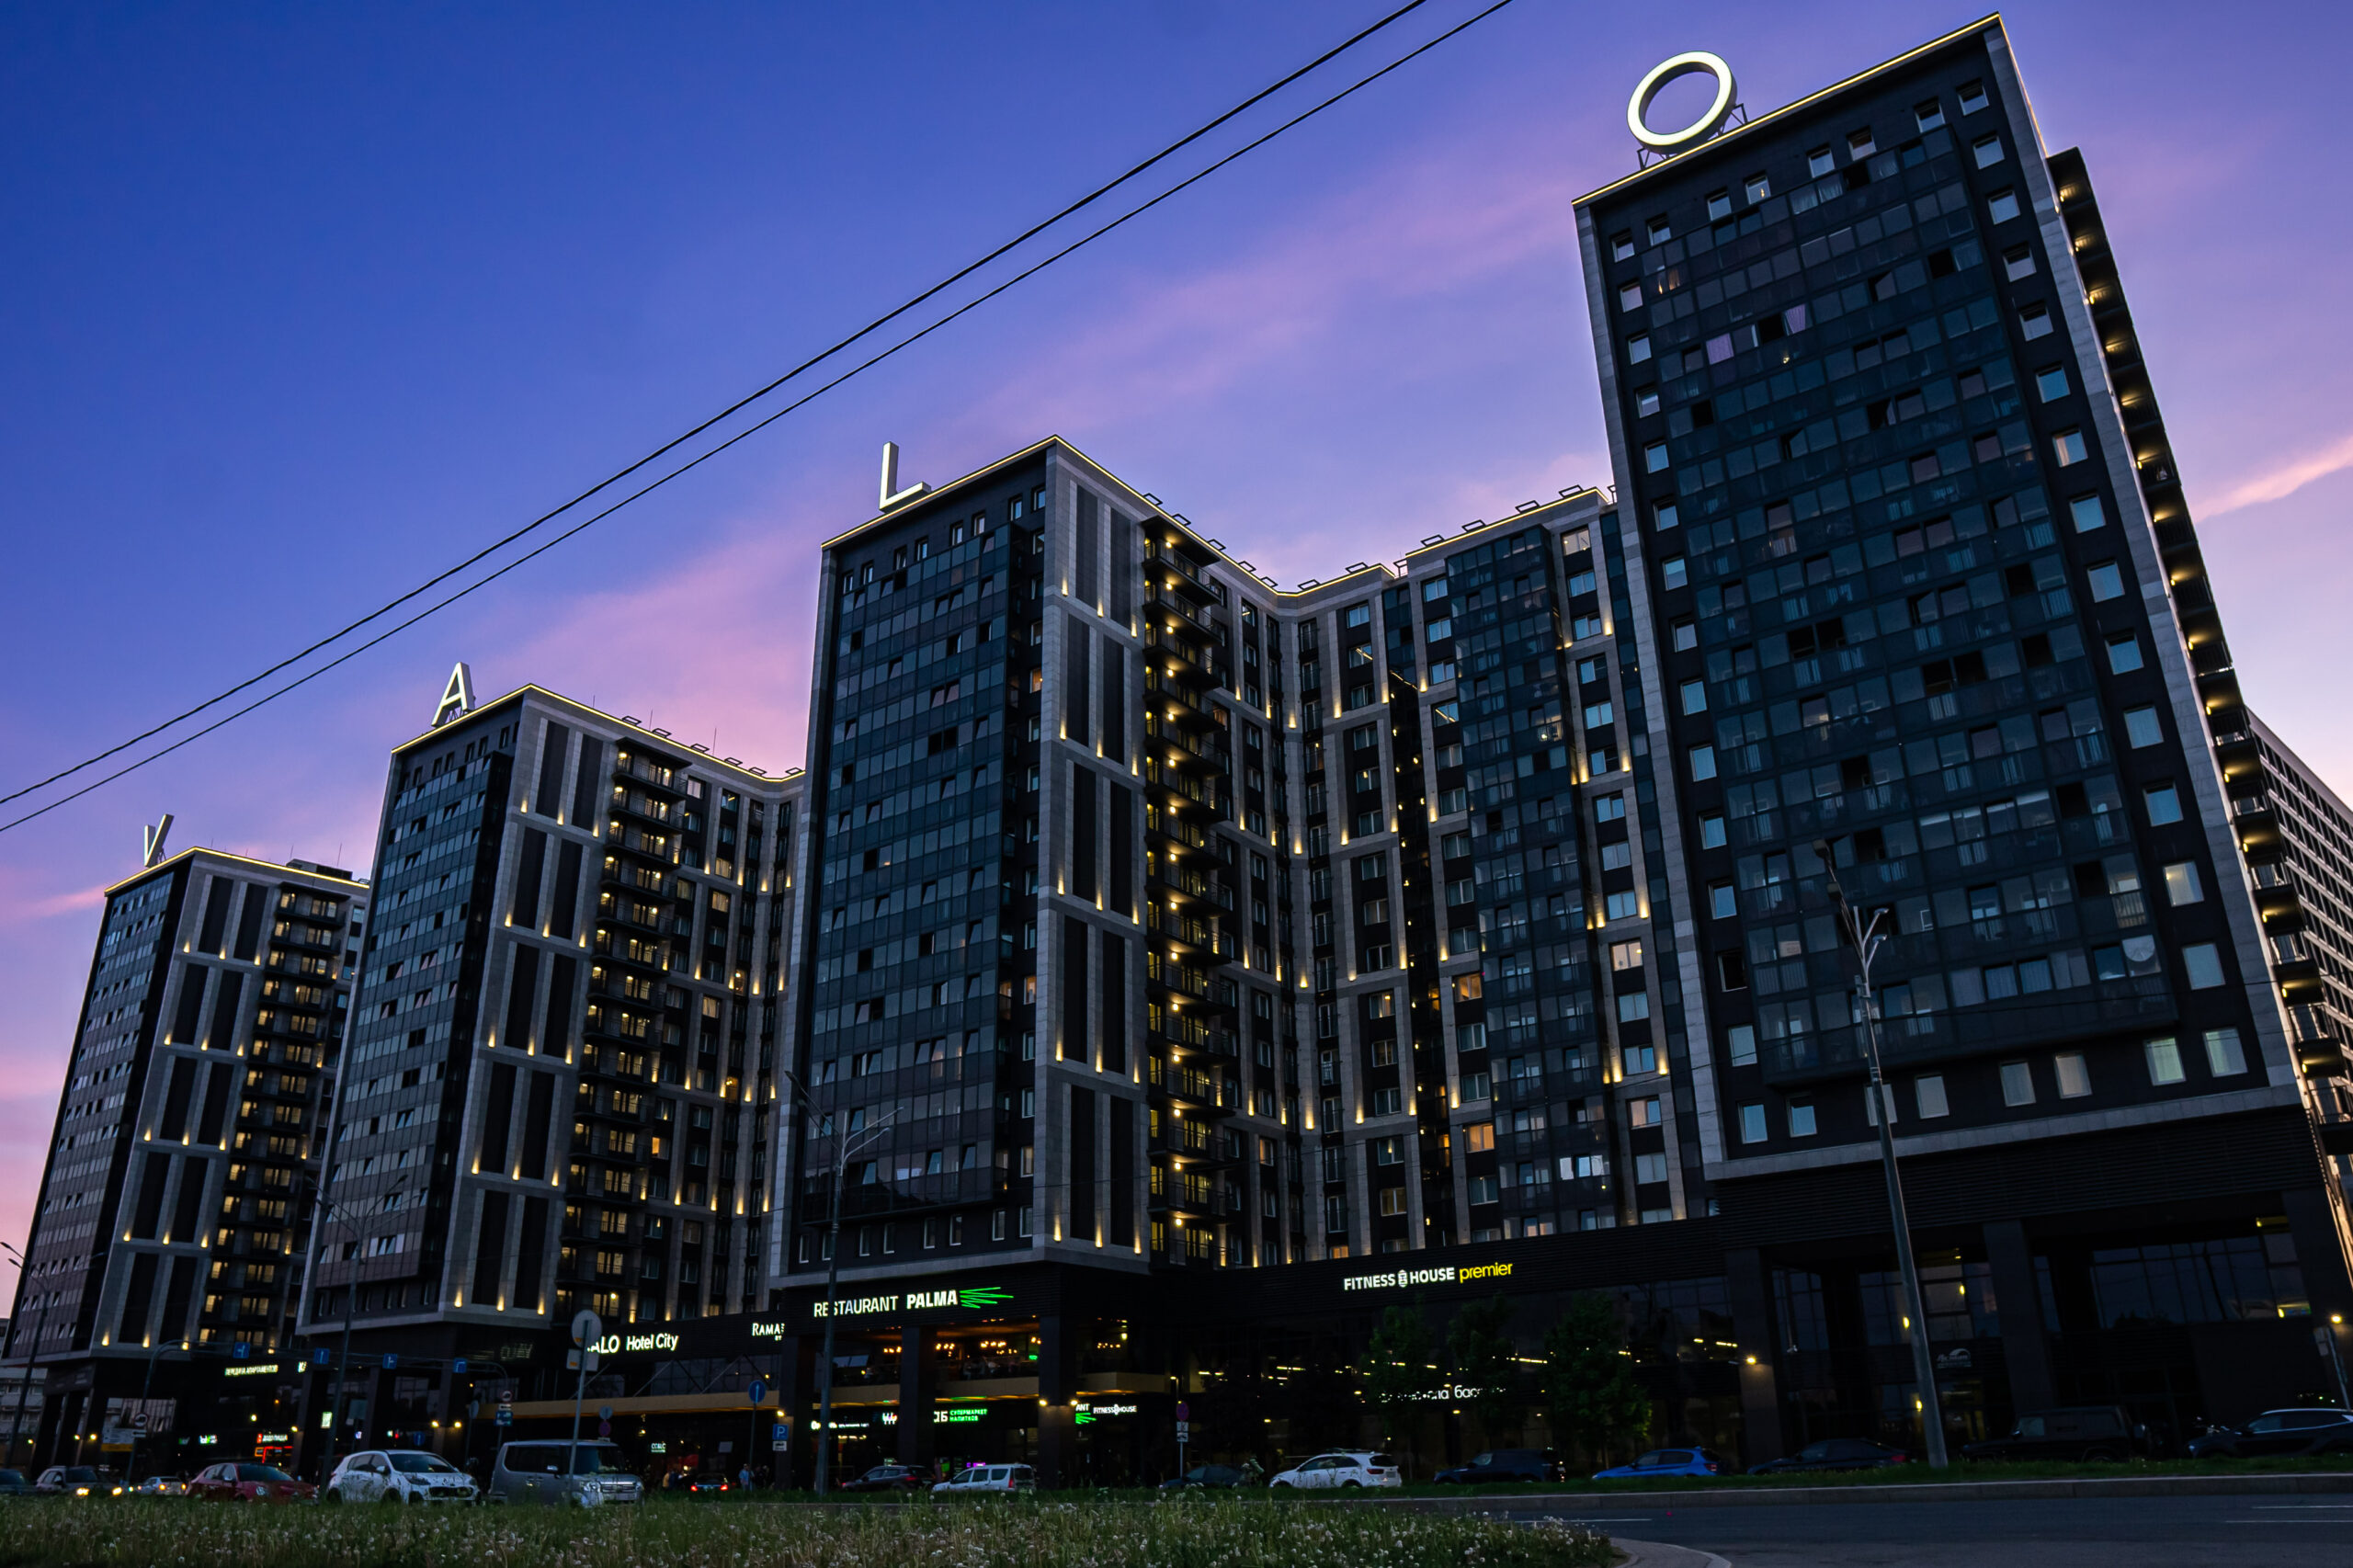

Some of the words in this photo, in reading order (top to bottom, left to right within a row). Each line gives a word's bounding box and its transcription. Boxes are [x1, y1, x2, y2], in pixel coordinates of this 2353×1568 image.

[1627, 51, 1736, 154] O
[879, 441, 931, 513] L
[431, 662, 476, 728] A
[144, 813, 175, 869] V
[1344, 1274, 1396, 1291] FITNESS
[1409, 1267, 1456, 1285] HOUSE
[1459, 1261, 1513, 1284] premier
[906, 1289, 959, 1310] PALMA
[586, 1335, 621, 1355] ALO
[625, 1334, 654, 1351] Hotel
[655, 1332, 679, 1352] City
[949, 1408, 988, 1416] СУПЕРМАРКЕТ
